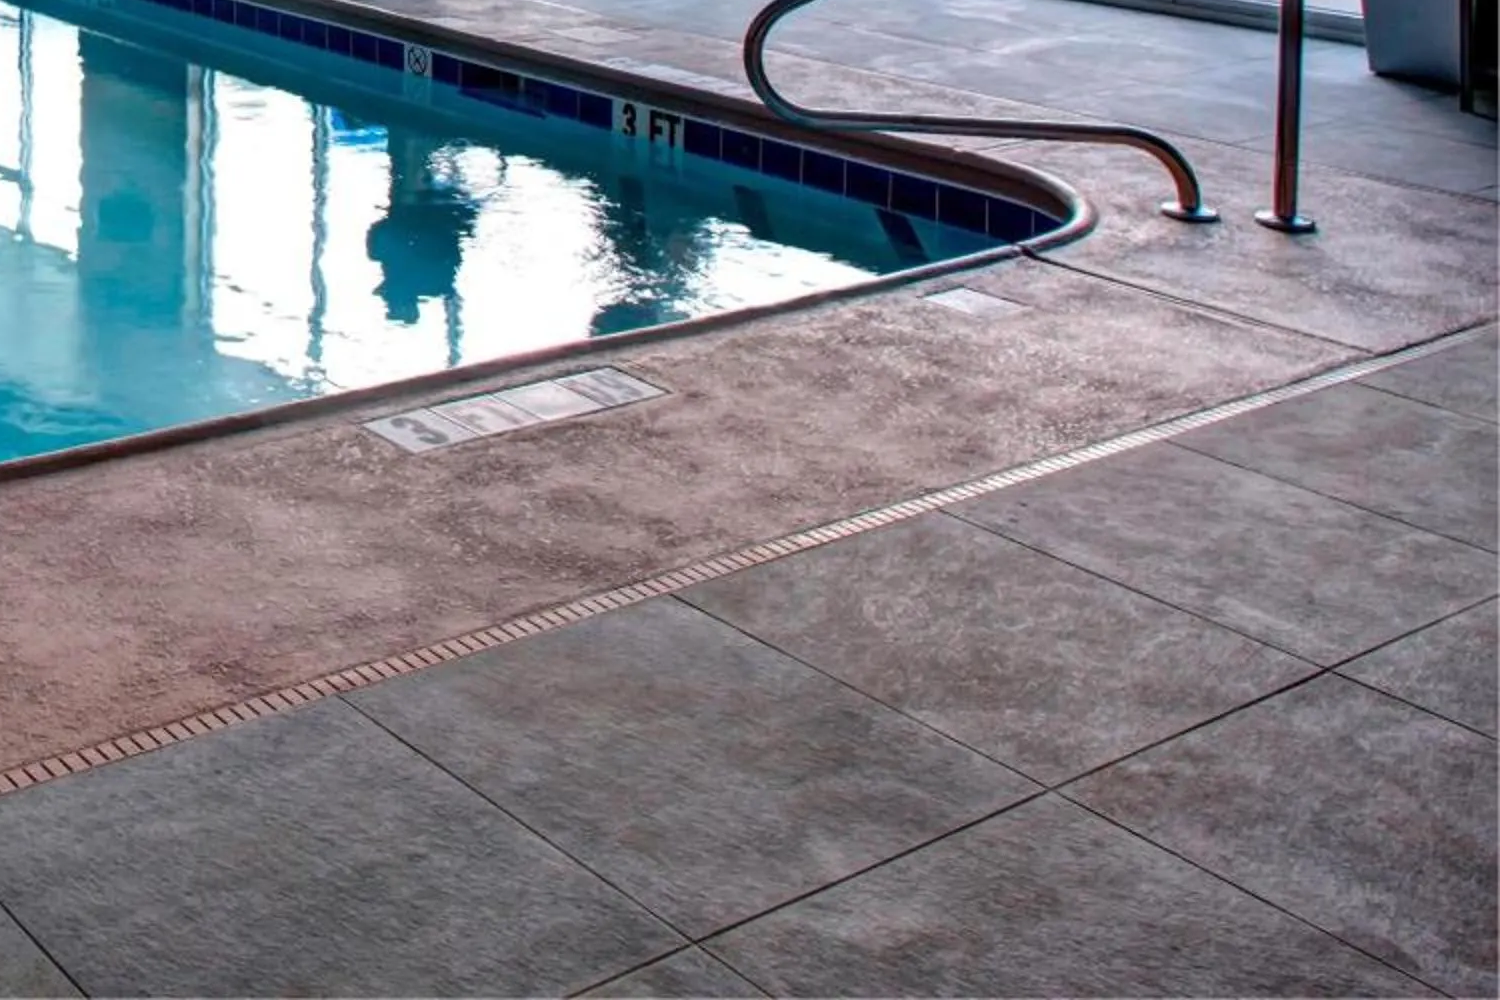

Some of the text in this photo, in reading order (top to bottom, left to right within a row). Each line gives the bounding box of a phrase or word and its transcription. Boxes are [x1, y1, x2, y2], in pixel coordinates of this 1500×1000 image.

[622, 103, 681, 148] 3 FT
[391, 416, 450, 446] 3
